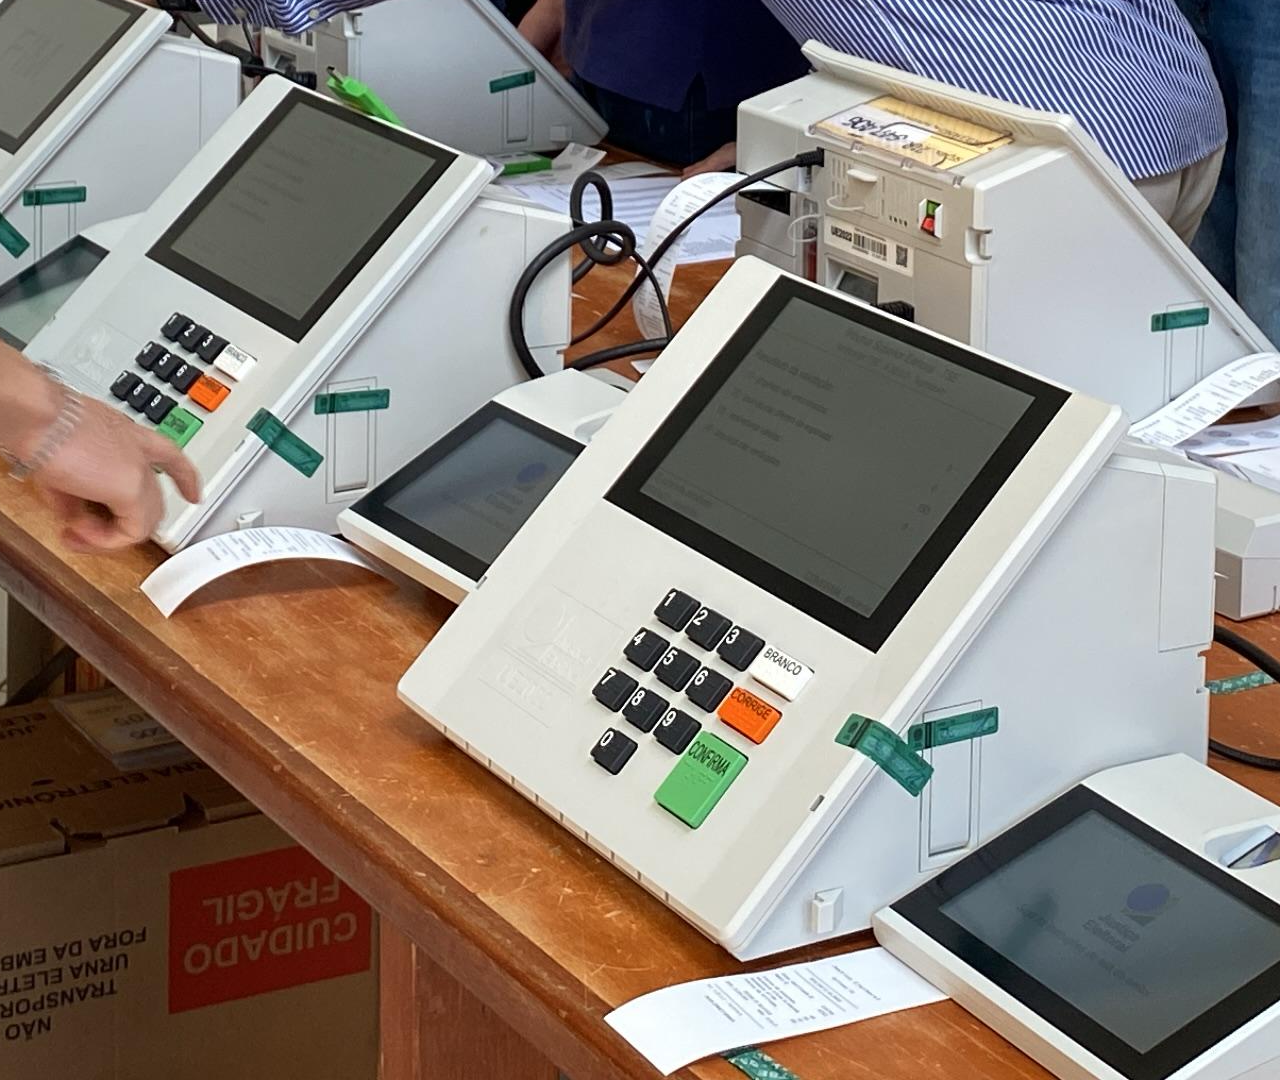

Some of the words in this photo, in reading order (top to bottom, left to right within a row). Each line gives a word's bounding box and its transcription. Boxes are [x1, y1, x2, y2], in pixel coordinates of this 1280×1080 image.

[183, 324, 196, 338] 2
[202, 334, 214, 347] 3
[158, 353, 171, 366] 5
[664, 591, 677, 606] 1
[693, 610, 708, 626] 2
[726, 628, 740, 644] 3
[633, 631, 646, 646] 4
[663, 650, 678, 665] 5
[694, 670, 708, 686] 6
[763, 647, 802, 676] BRANCO
[601, 670, 616, 685] 7
[631, 690, 644, 706] 8
[663, 710, 676, 727] 9
[730, 688, 773, 720] CORRIGE
[600, 730, 614, 746] 0
[151, 761, 206, 777] RNA
[688, 740, 732, 777] CONFIRMA
[202, 875, 340, 925] FRÁGIL
[53, 940, 83, 962] DA
[88, 926, 147, 953] FORA
[184, 912, 357, 974] CUIDADO
[69, 953, 129, 979] URNA
[5, 1016, 52, 1041] NÃO
